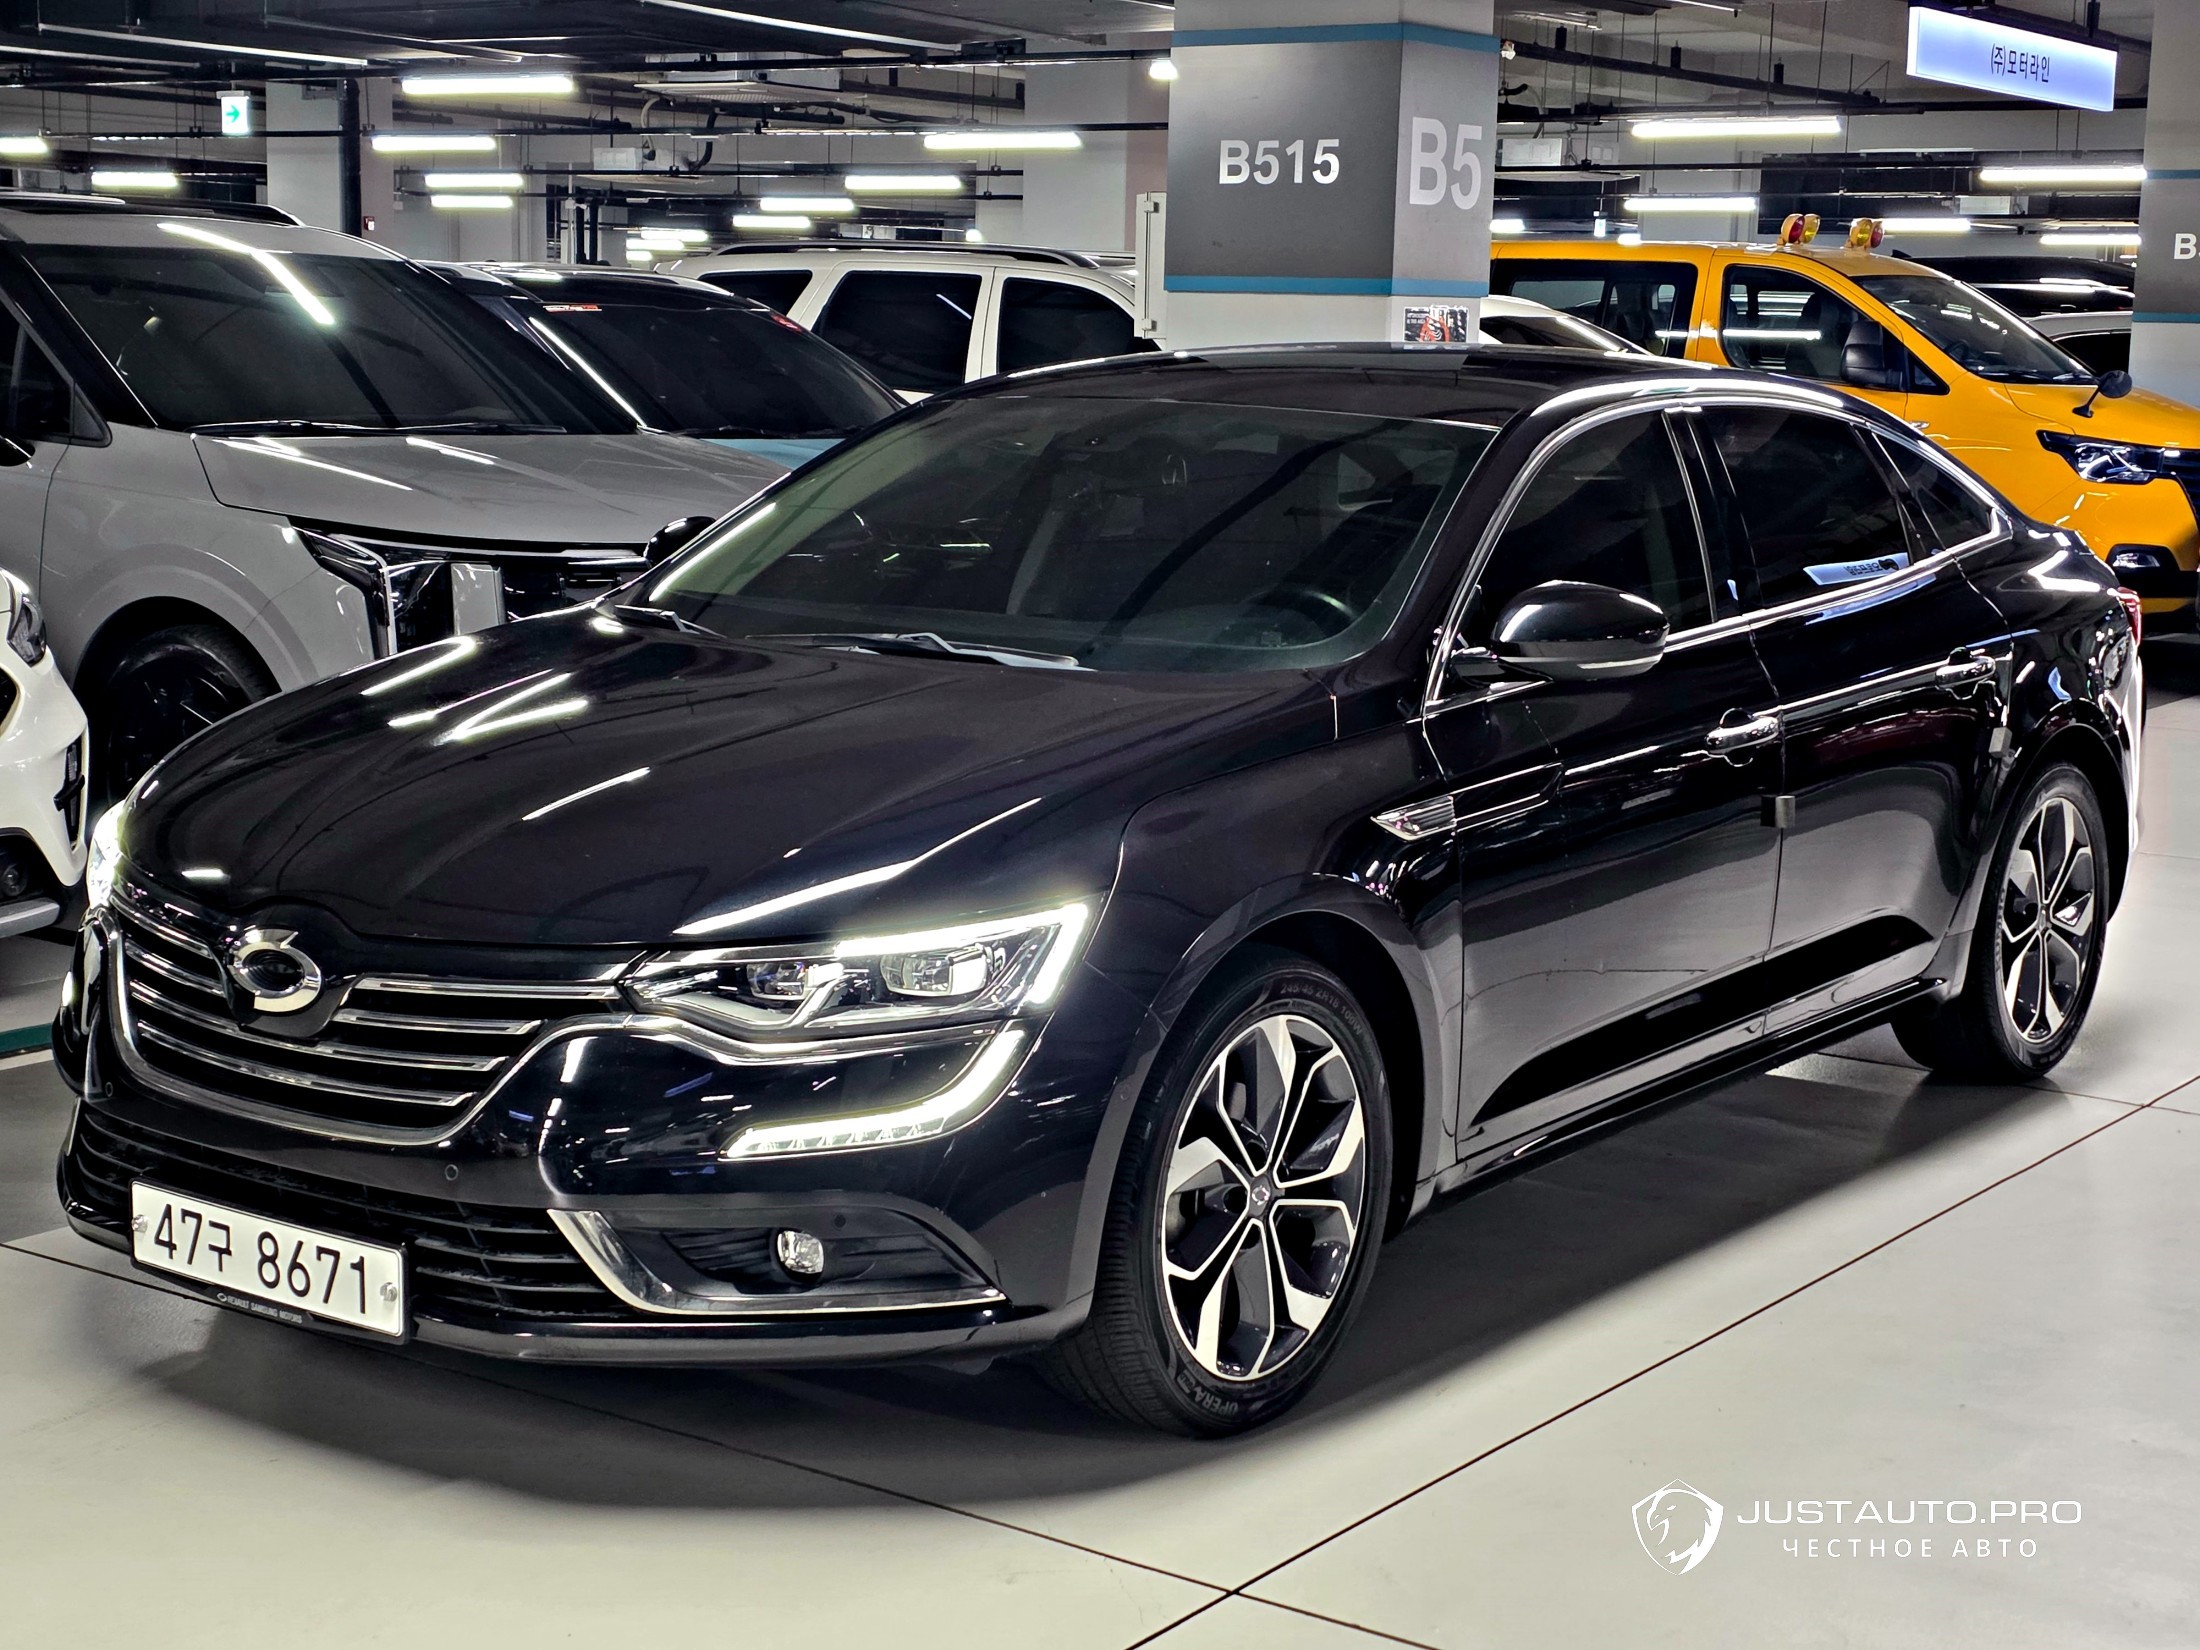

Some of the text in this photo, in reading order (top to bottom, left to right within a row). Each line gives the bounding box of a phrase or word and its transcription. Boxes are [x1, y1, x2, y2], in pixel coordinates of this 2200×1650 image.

[1991, 43, 2050, 83] (주)모터라인
[1218, 138, 1340, 185] B515
[1408, 116, 1484, 210] B5
[2173, 232, 2200, 260] B
[153, 1203, 367, 1315] 47구 8671
